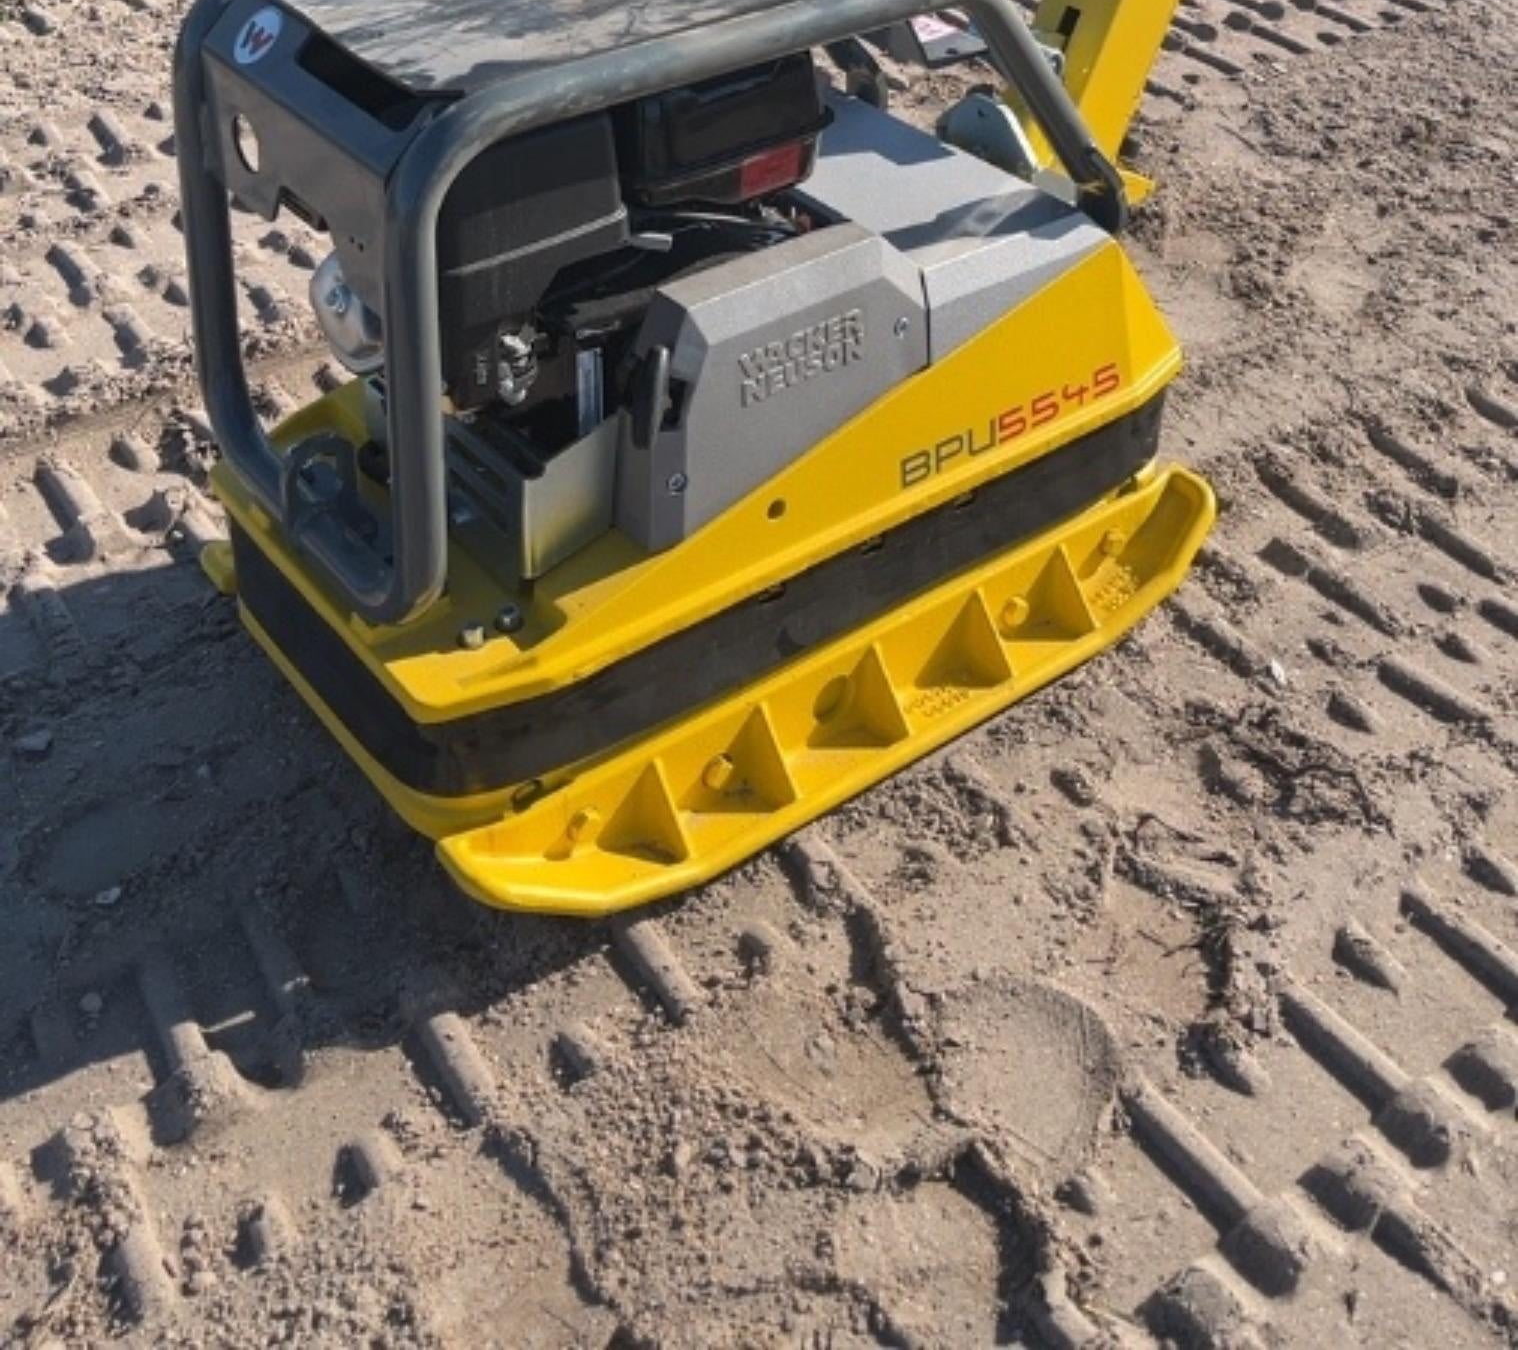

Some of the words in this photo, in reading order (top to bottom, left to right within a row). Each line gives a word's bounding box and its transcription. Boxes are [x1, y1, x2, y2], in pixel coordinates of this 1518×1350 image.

[737, 308, 864, 379] WACKER
[740, 338, 862, 408] NEUSON
[901, 362, 1121, 488] BPU5545
